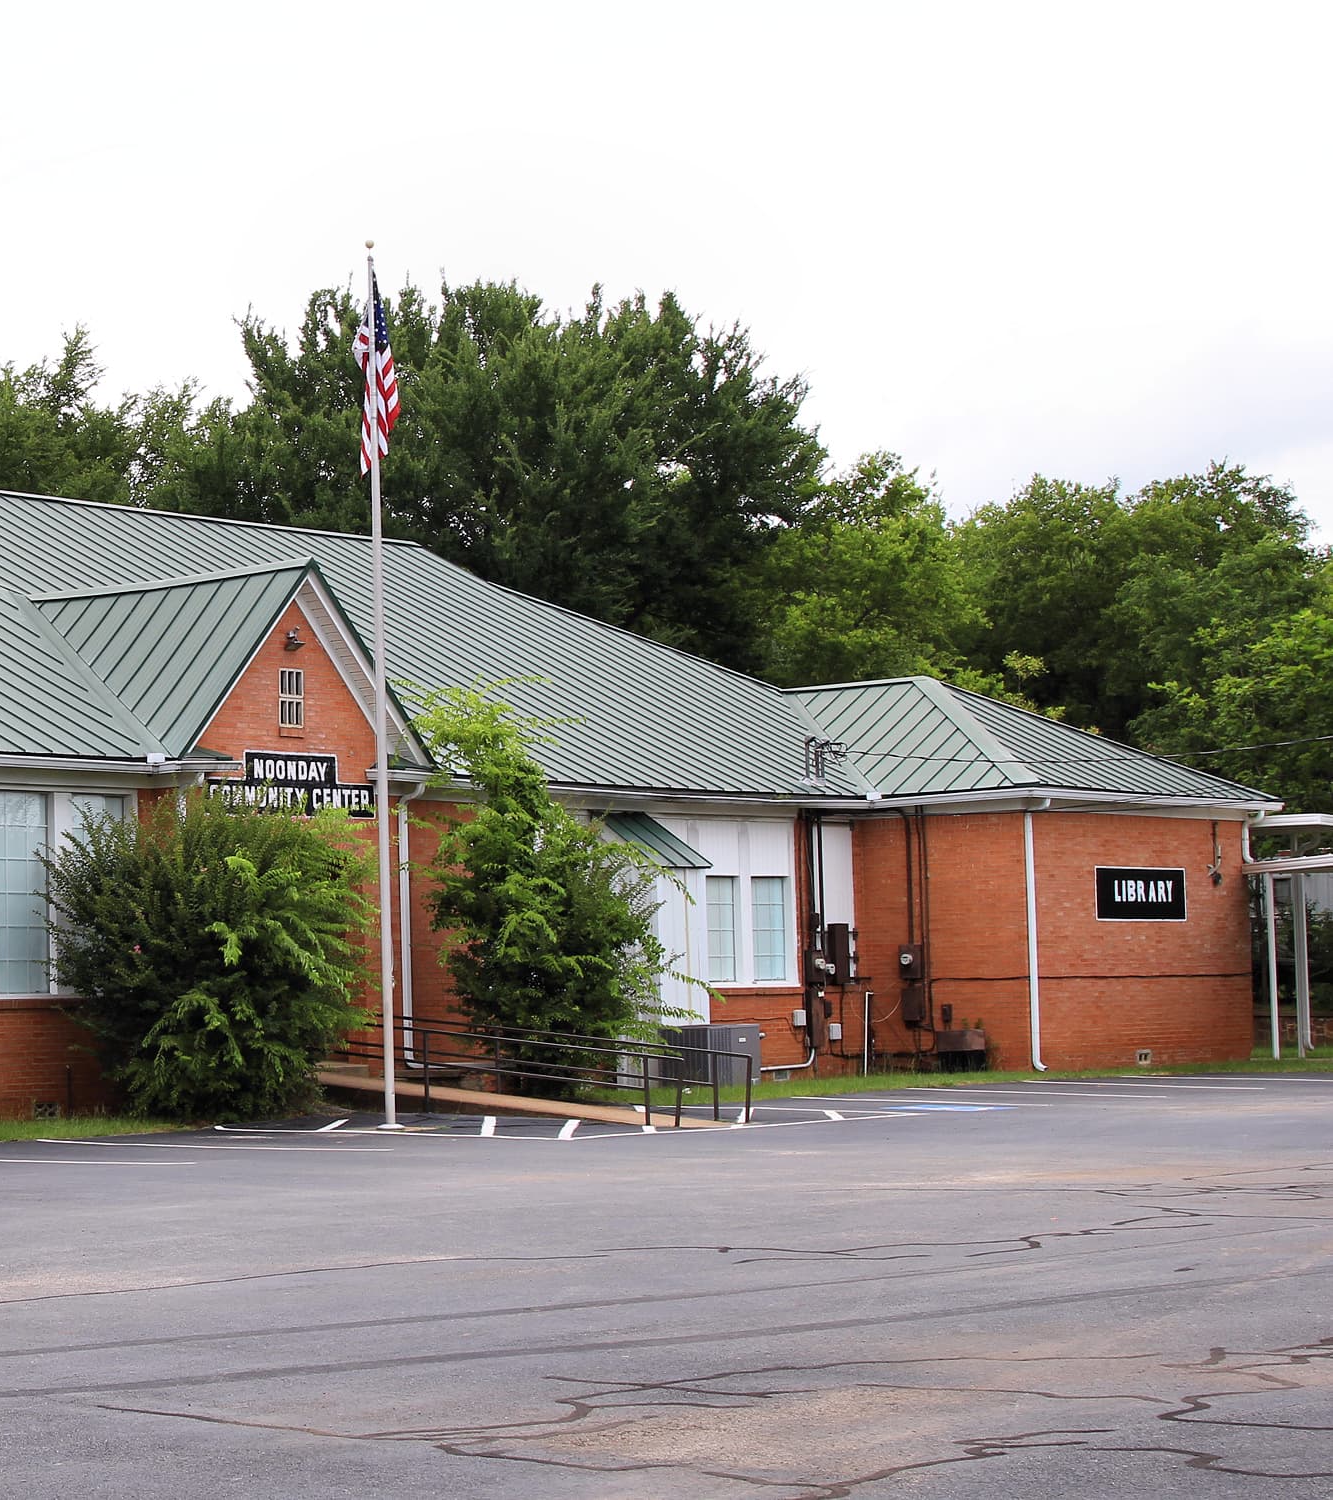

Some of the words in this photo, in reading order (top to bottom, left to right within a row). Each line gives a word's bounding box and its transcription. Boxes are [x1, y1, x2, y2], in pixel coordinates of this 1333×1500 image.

[253, 758, 327, 781] NOONDAY
[312, 788, 369, 810] CENTER
[1114, 880, 1173, 902] LIBRARY
